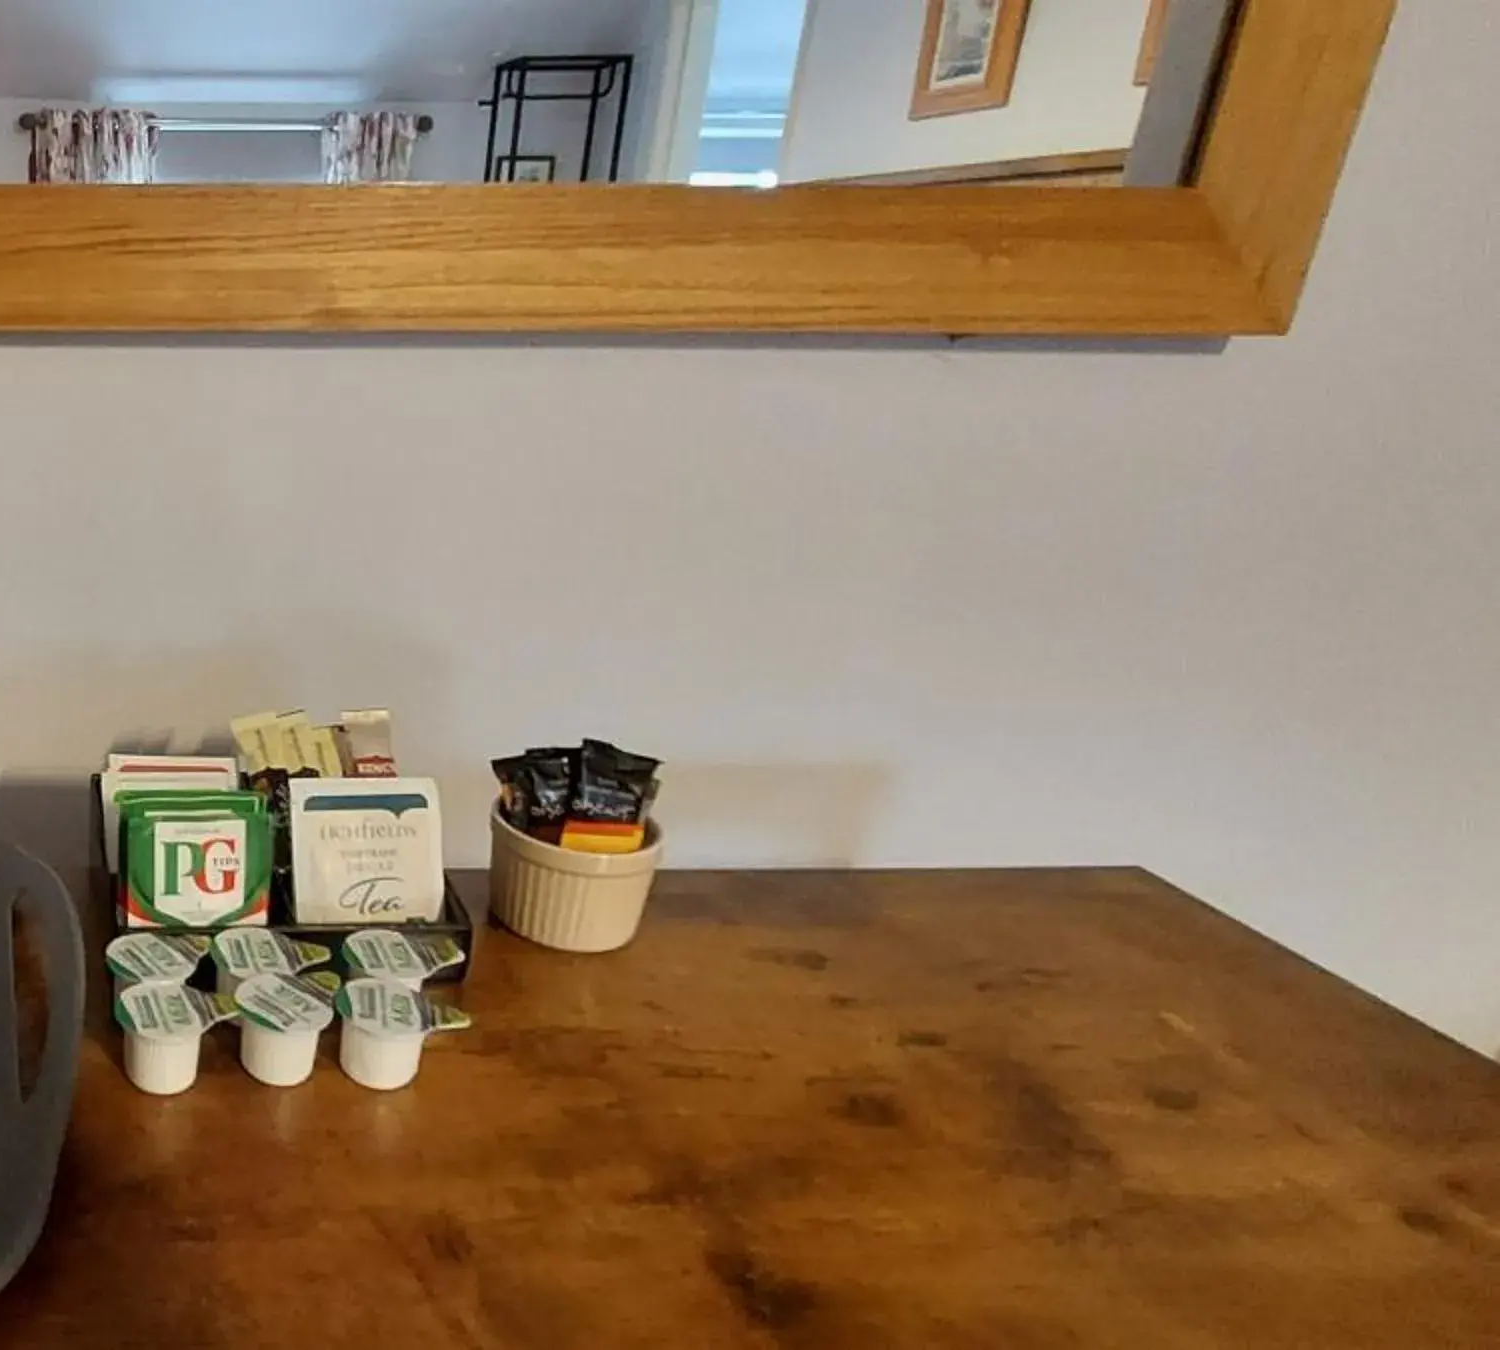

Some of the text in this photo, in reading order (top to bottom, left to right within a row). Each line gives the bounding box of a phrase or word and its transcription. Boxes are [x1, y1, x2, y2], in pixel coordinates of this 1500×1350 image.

[161, 838, 235, 895] PG
[212, 857, 240, 866] TIPS
[338, 876, 405, 915] Tea
